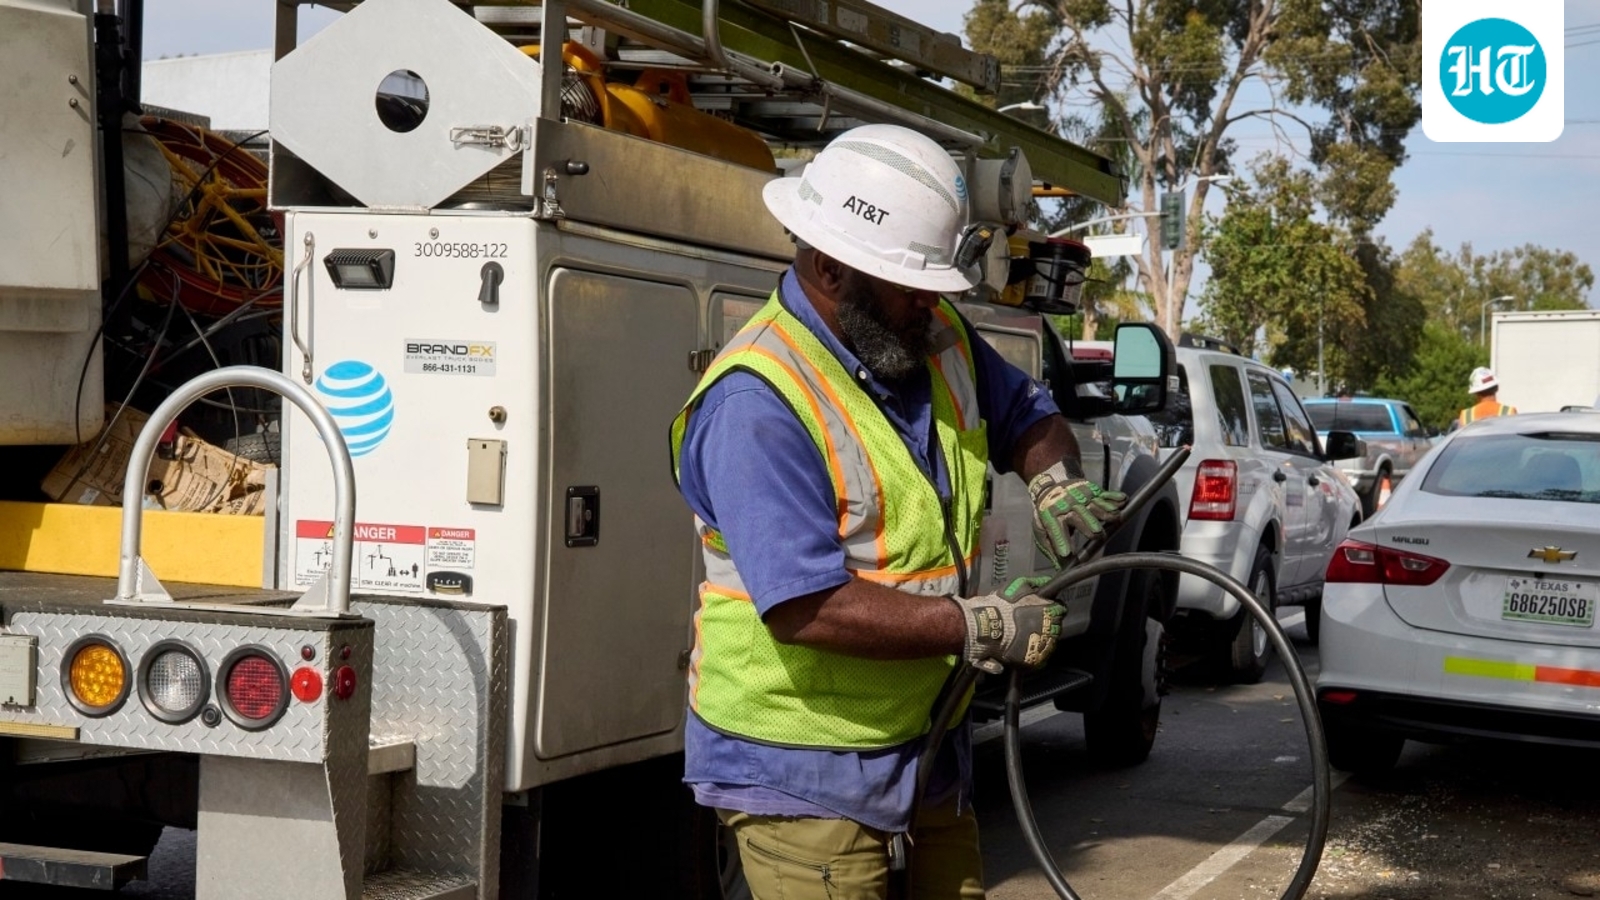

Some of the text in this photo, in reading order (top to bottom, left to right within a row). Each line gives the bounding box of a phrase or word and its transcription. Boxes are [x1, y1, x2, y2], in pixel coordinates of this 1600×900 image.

[842, 195, 890, 226] AT&T
[414, 242, 508, 258] 3009588-122
[406, 343, 493, 357] BRANDFX
[422, 363, 476, 373] 866-431-1131
[354, 526, 397, 540] ANGER
[440, 529, 470, 539] DANGER
[1391, 535, 1430, 546] MALIBU
[1534, 581, 1569, 592] TEXAS
[1509, 592, 1588, 619] 686250SB
